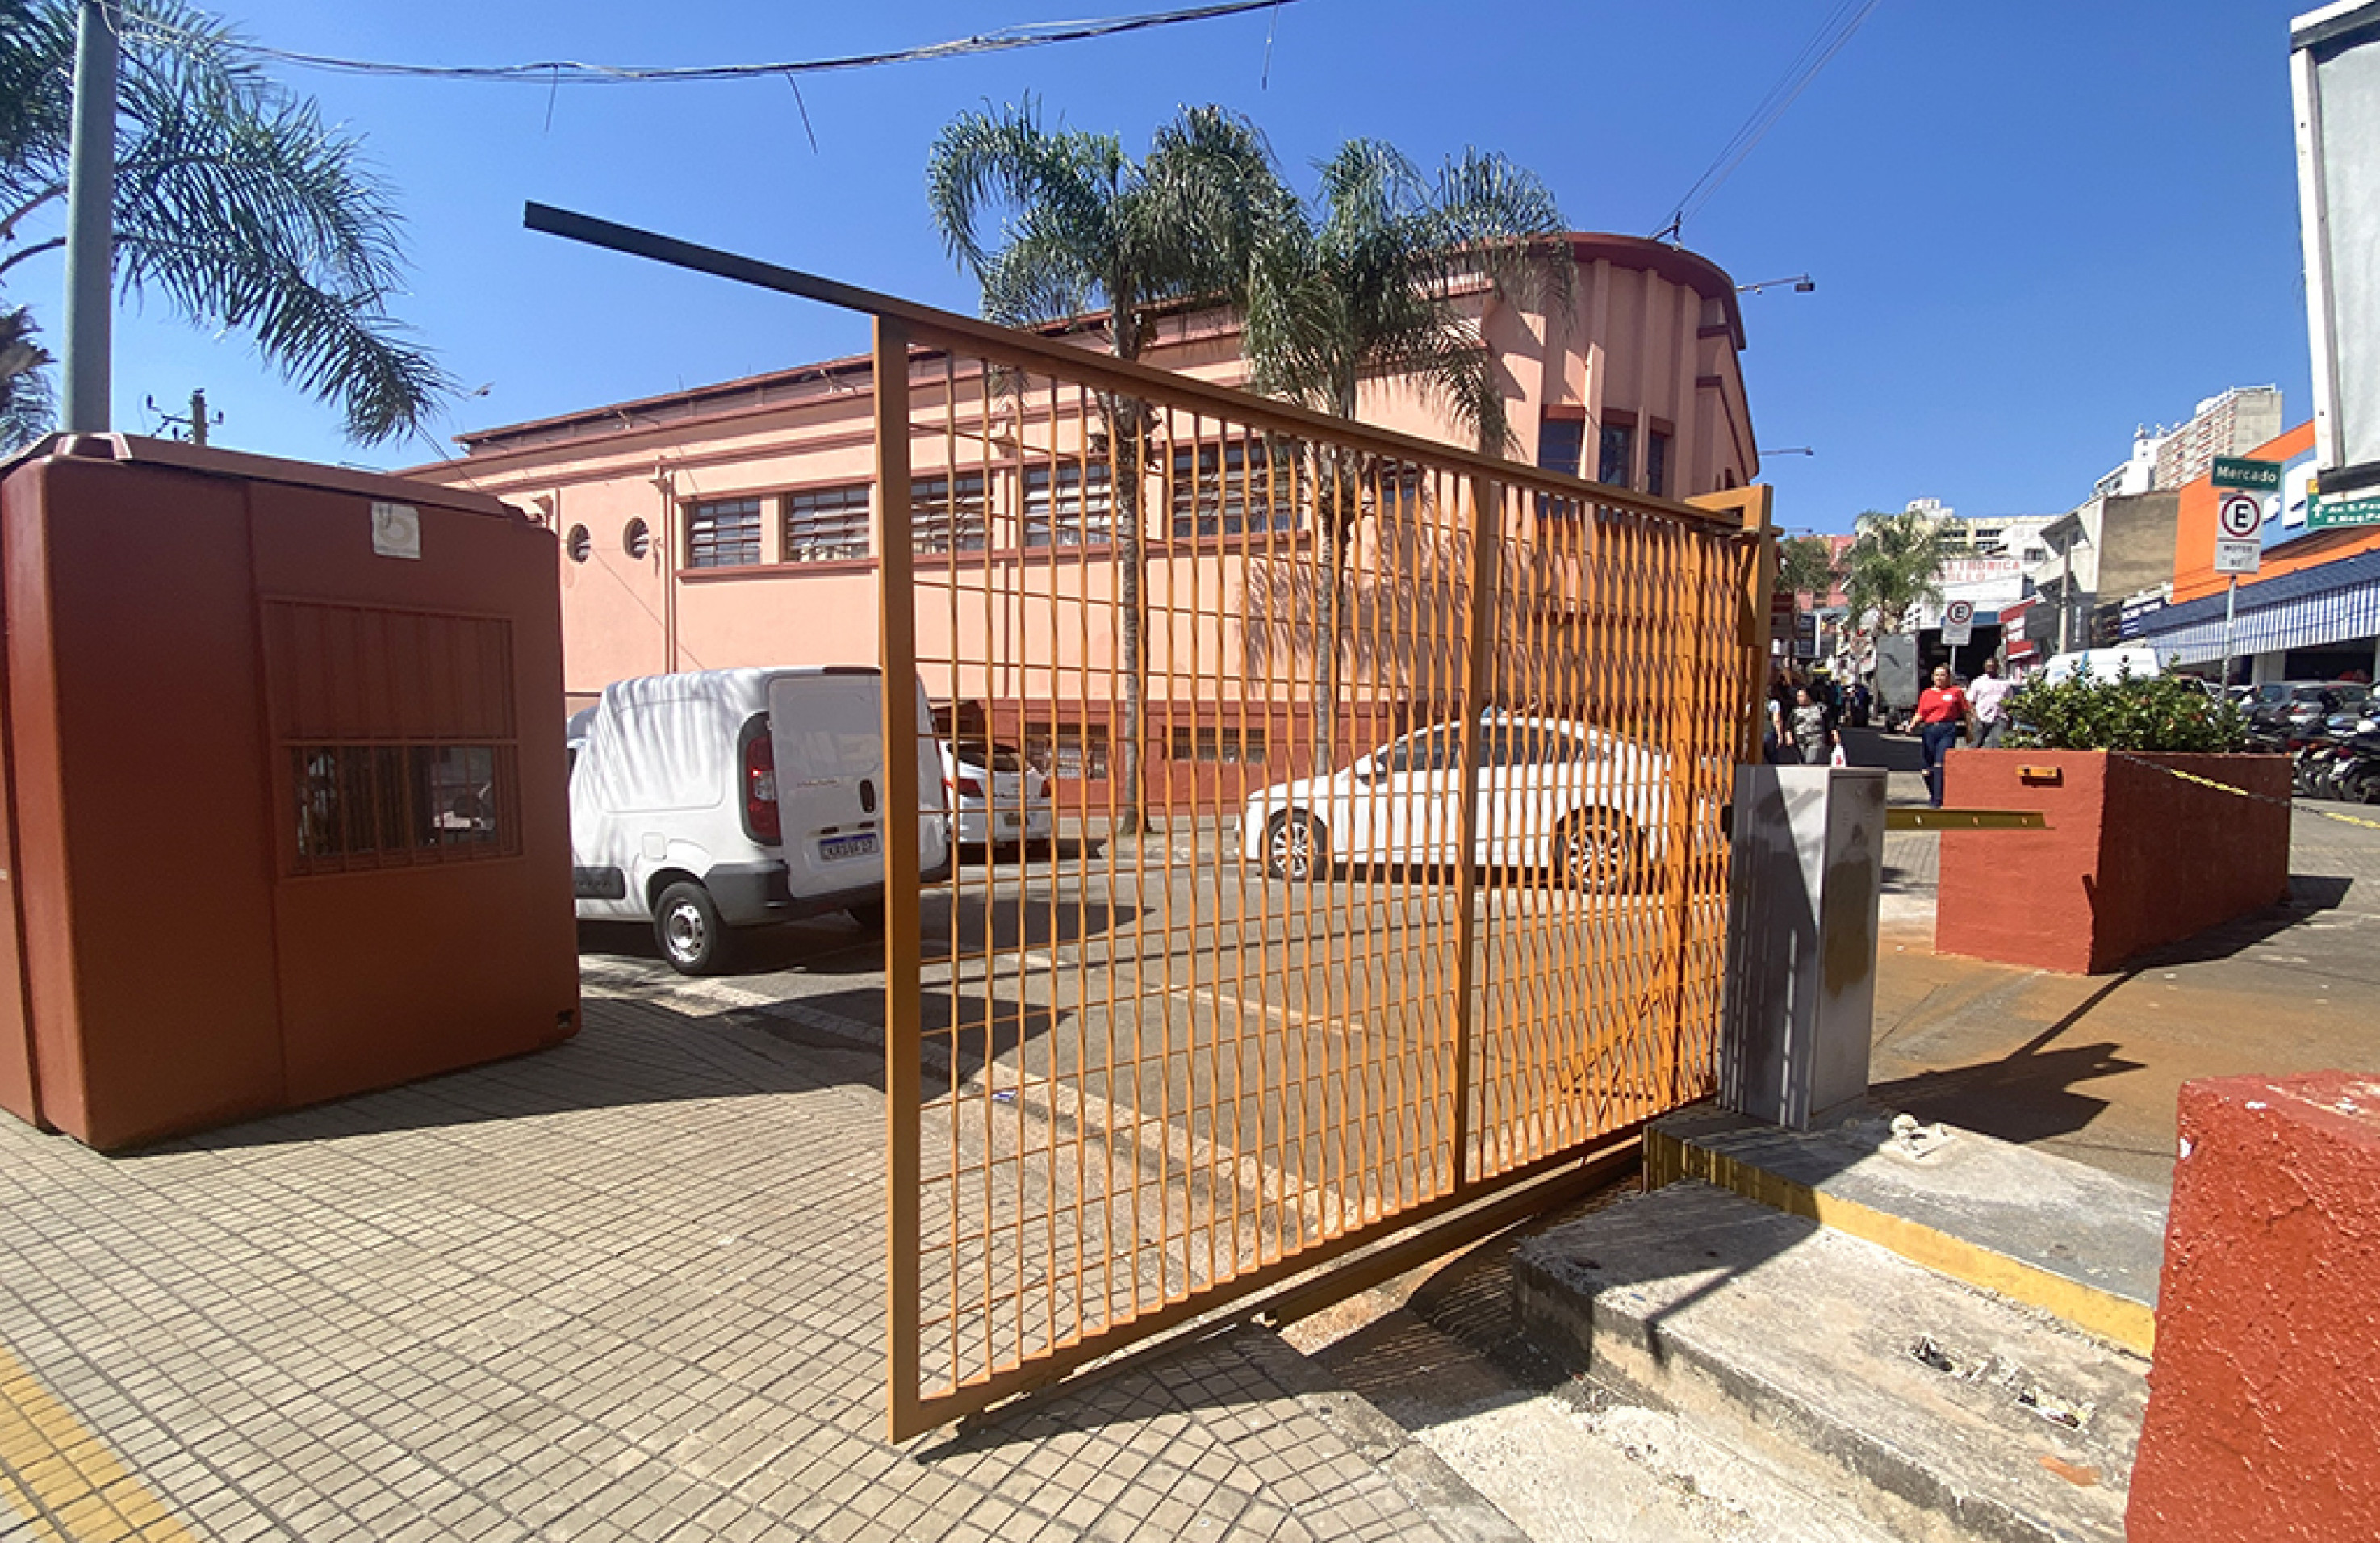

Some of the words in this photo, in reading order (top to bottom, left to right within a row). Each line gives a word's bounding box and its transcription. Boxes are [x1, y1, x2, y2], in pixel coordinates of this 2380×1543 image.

[2216, 466, 2278, 483] Mercado
[2235, 504, 2248, 528] E
[1955, 607, 1964, 618] E
